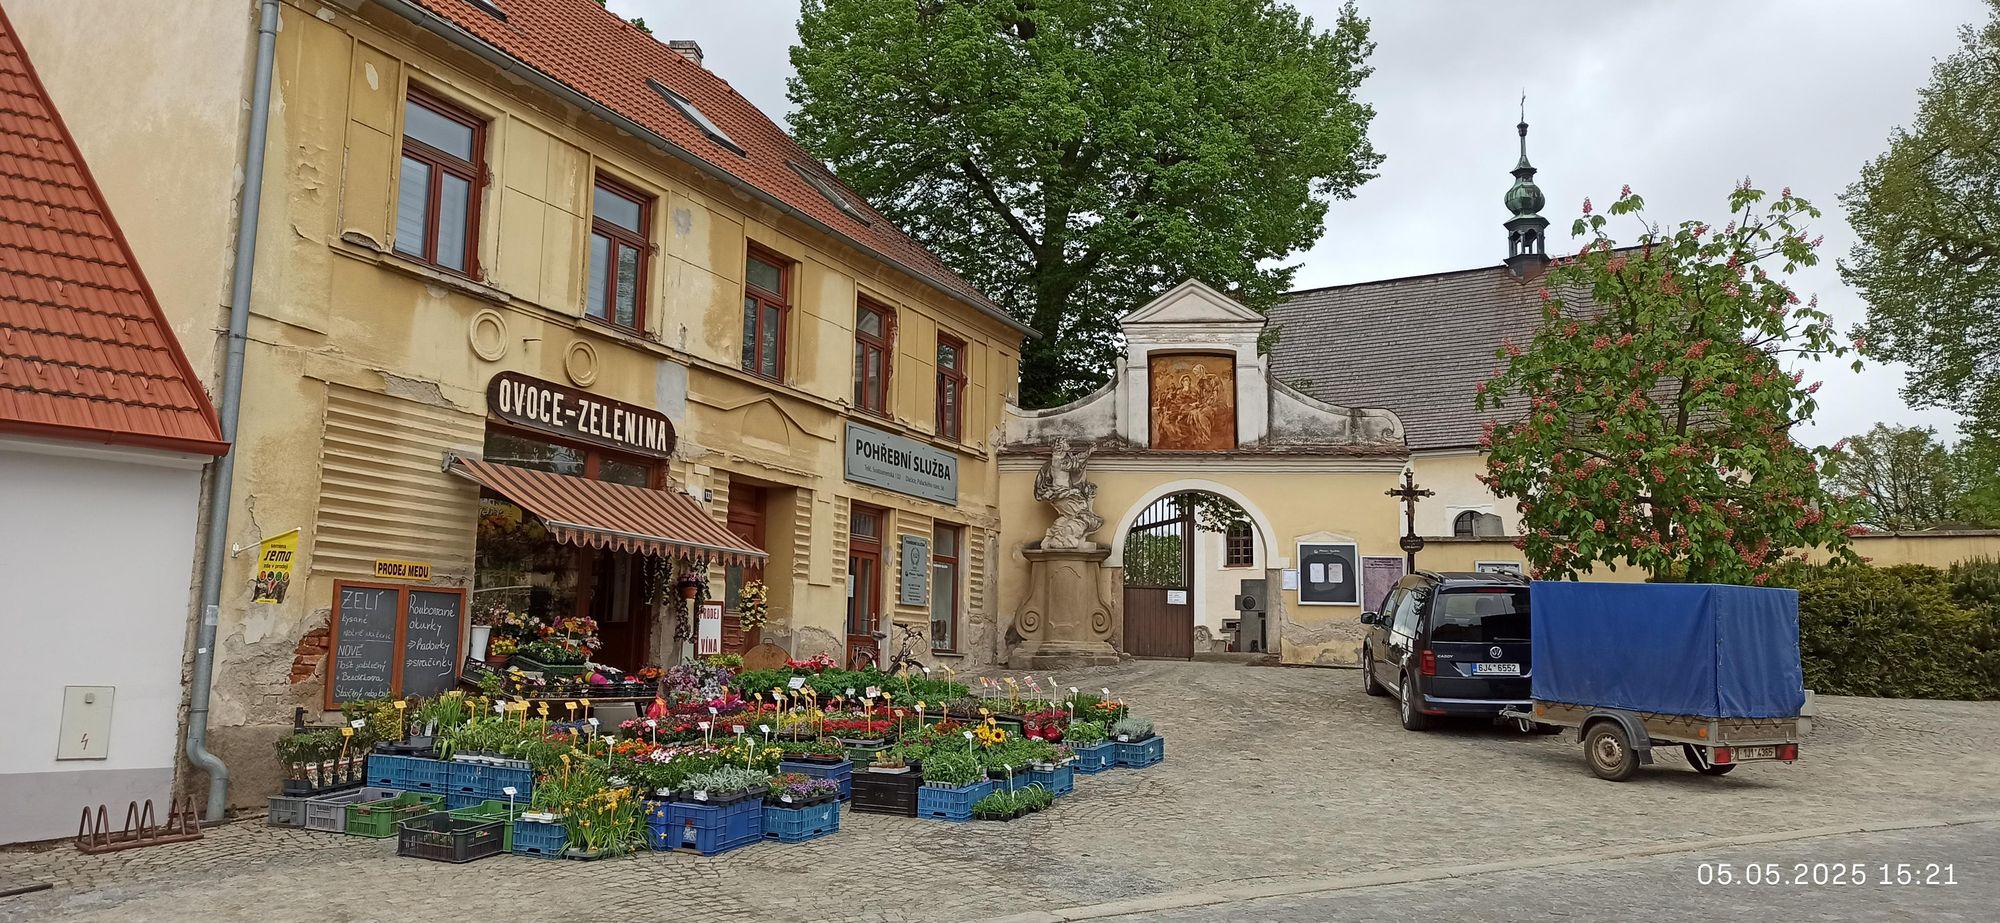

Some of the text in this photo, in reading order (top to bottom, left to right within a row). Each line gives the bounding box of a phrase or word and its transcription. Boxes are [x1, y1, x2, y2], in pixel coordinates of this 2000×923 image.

[499, 378, 667, 451] OVOCE-ZELENINA
[856, 439, 951, 481] POHŘEBNÍ SLUŽBA
[377, 562, 429, 578] PRODEJ MEDU
[341, 590, 385, 611] ZELÍ
[408, 593, 456, 618] Roubované
[337, 643, 364, 656] NOVÉ
[700, 636, 717, 653] VÍNA
[1497, 664, 1516, 672] 6552
